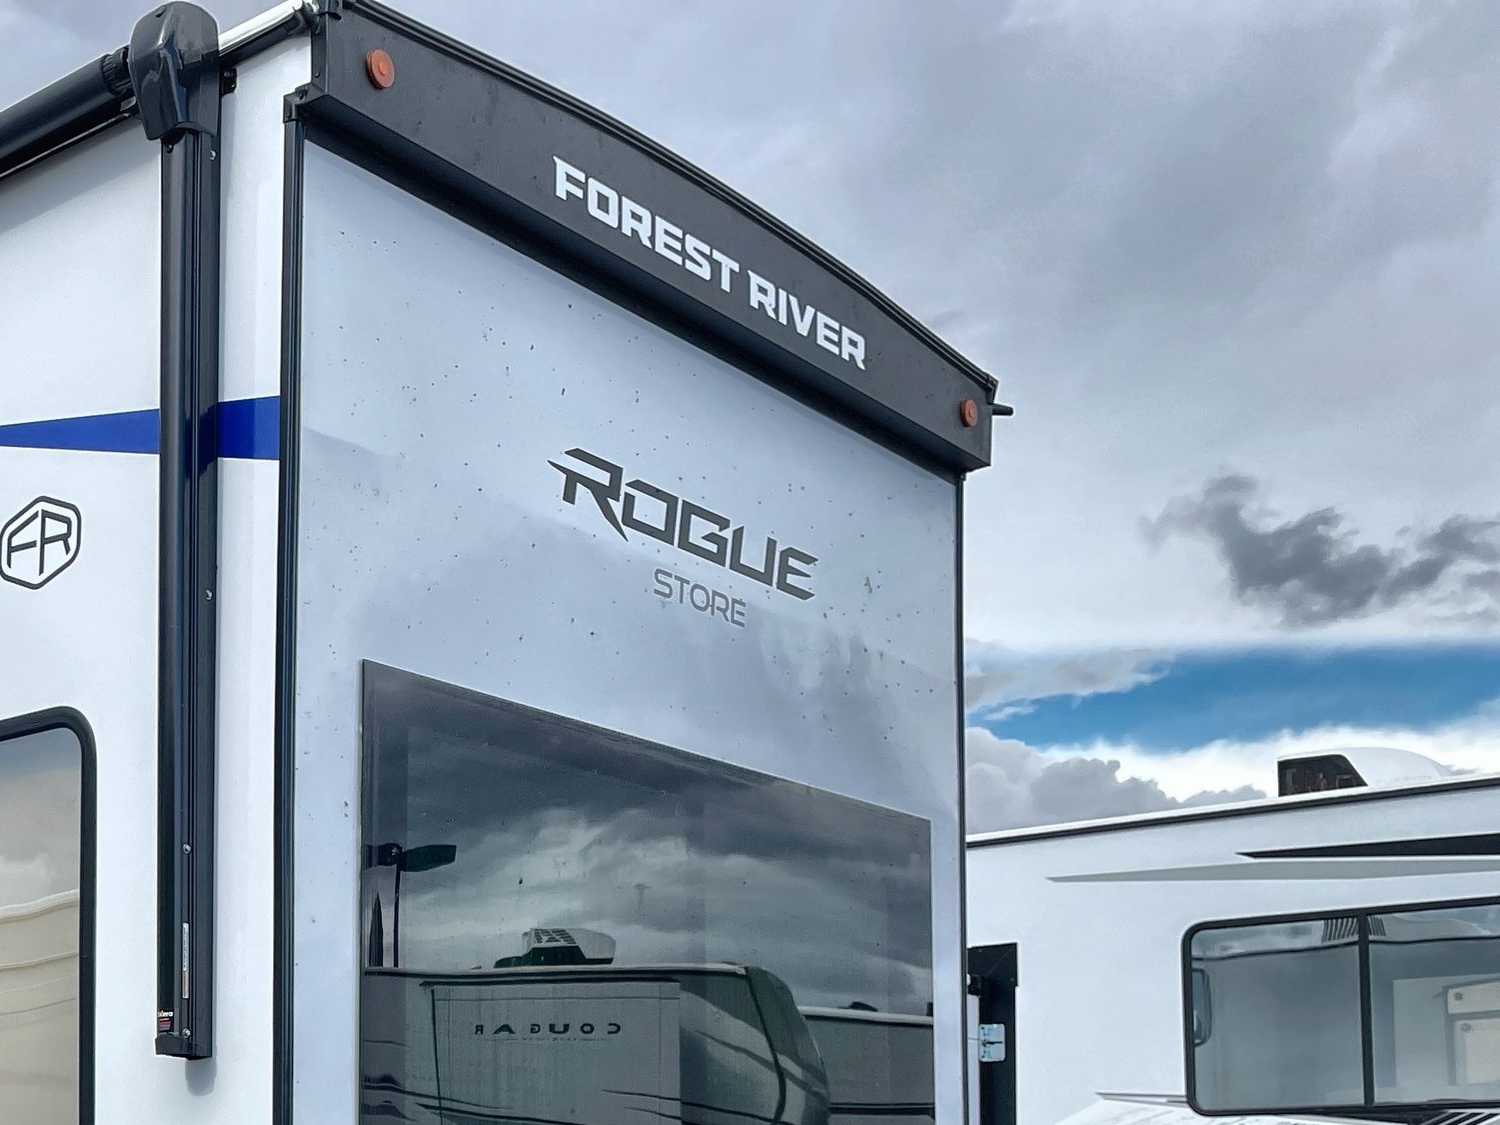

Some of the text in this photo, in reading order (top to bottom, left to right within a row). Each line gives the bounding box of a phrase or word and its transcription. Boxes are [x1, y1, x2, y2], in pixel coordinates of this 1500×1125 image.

[553, 155, 866, 370] FOREST RIVER
[6, 508, 72, 577] FR
[547, 448, 819, 601] ROGUE
[653, 568, 746, 628] STORE
